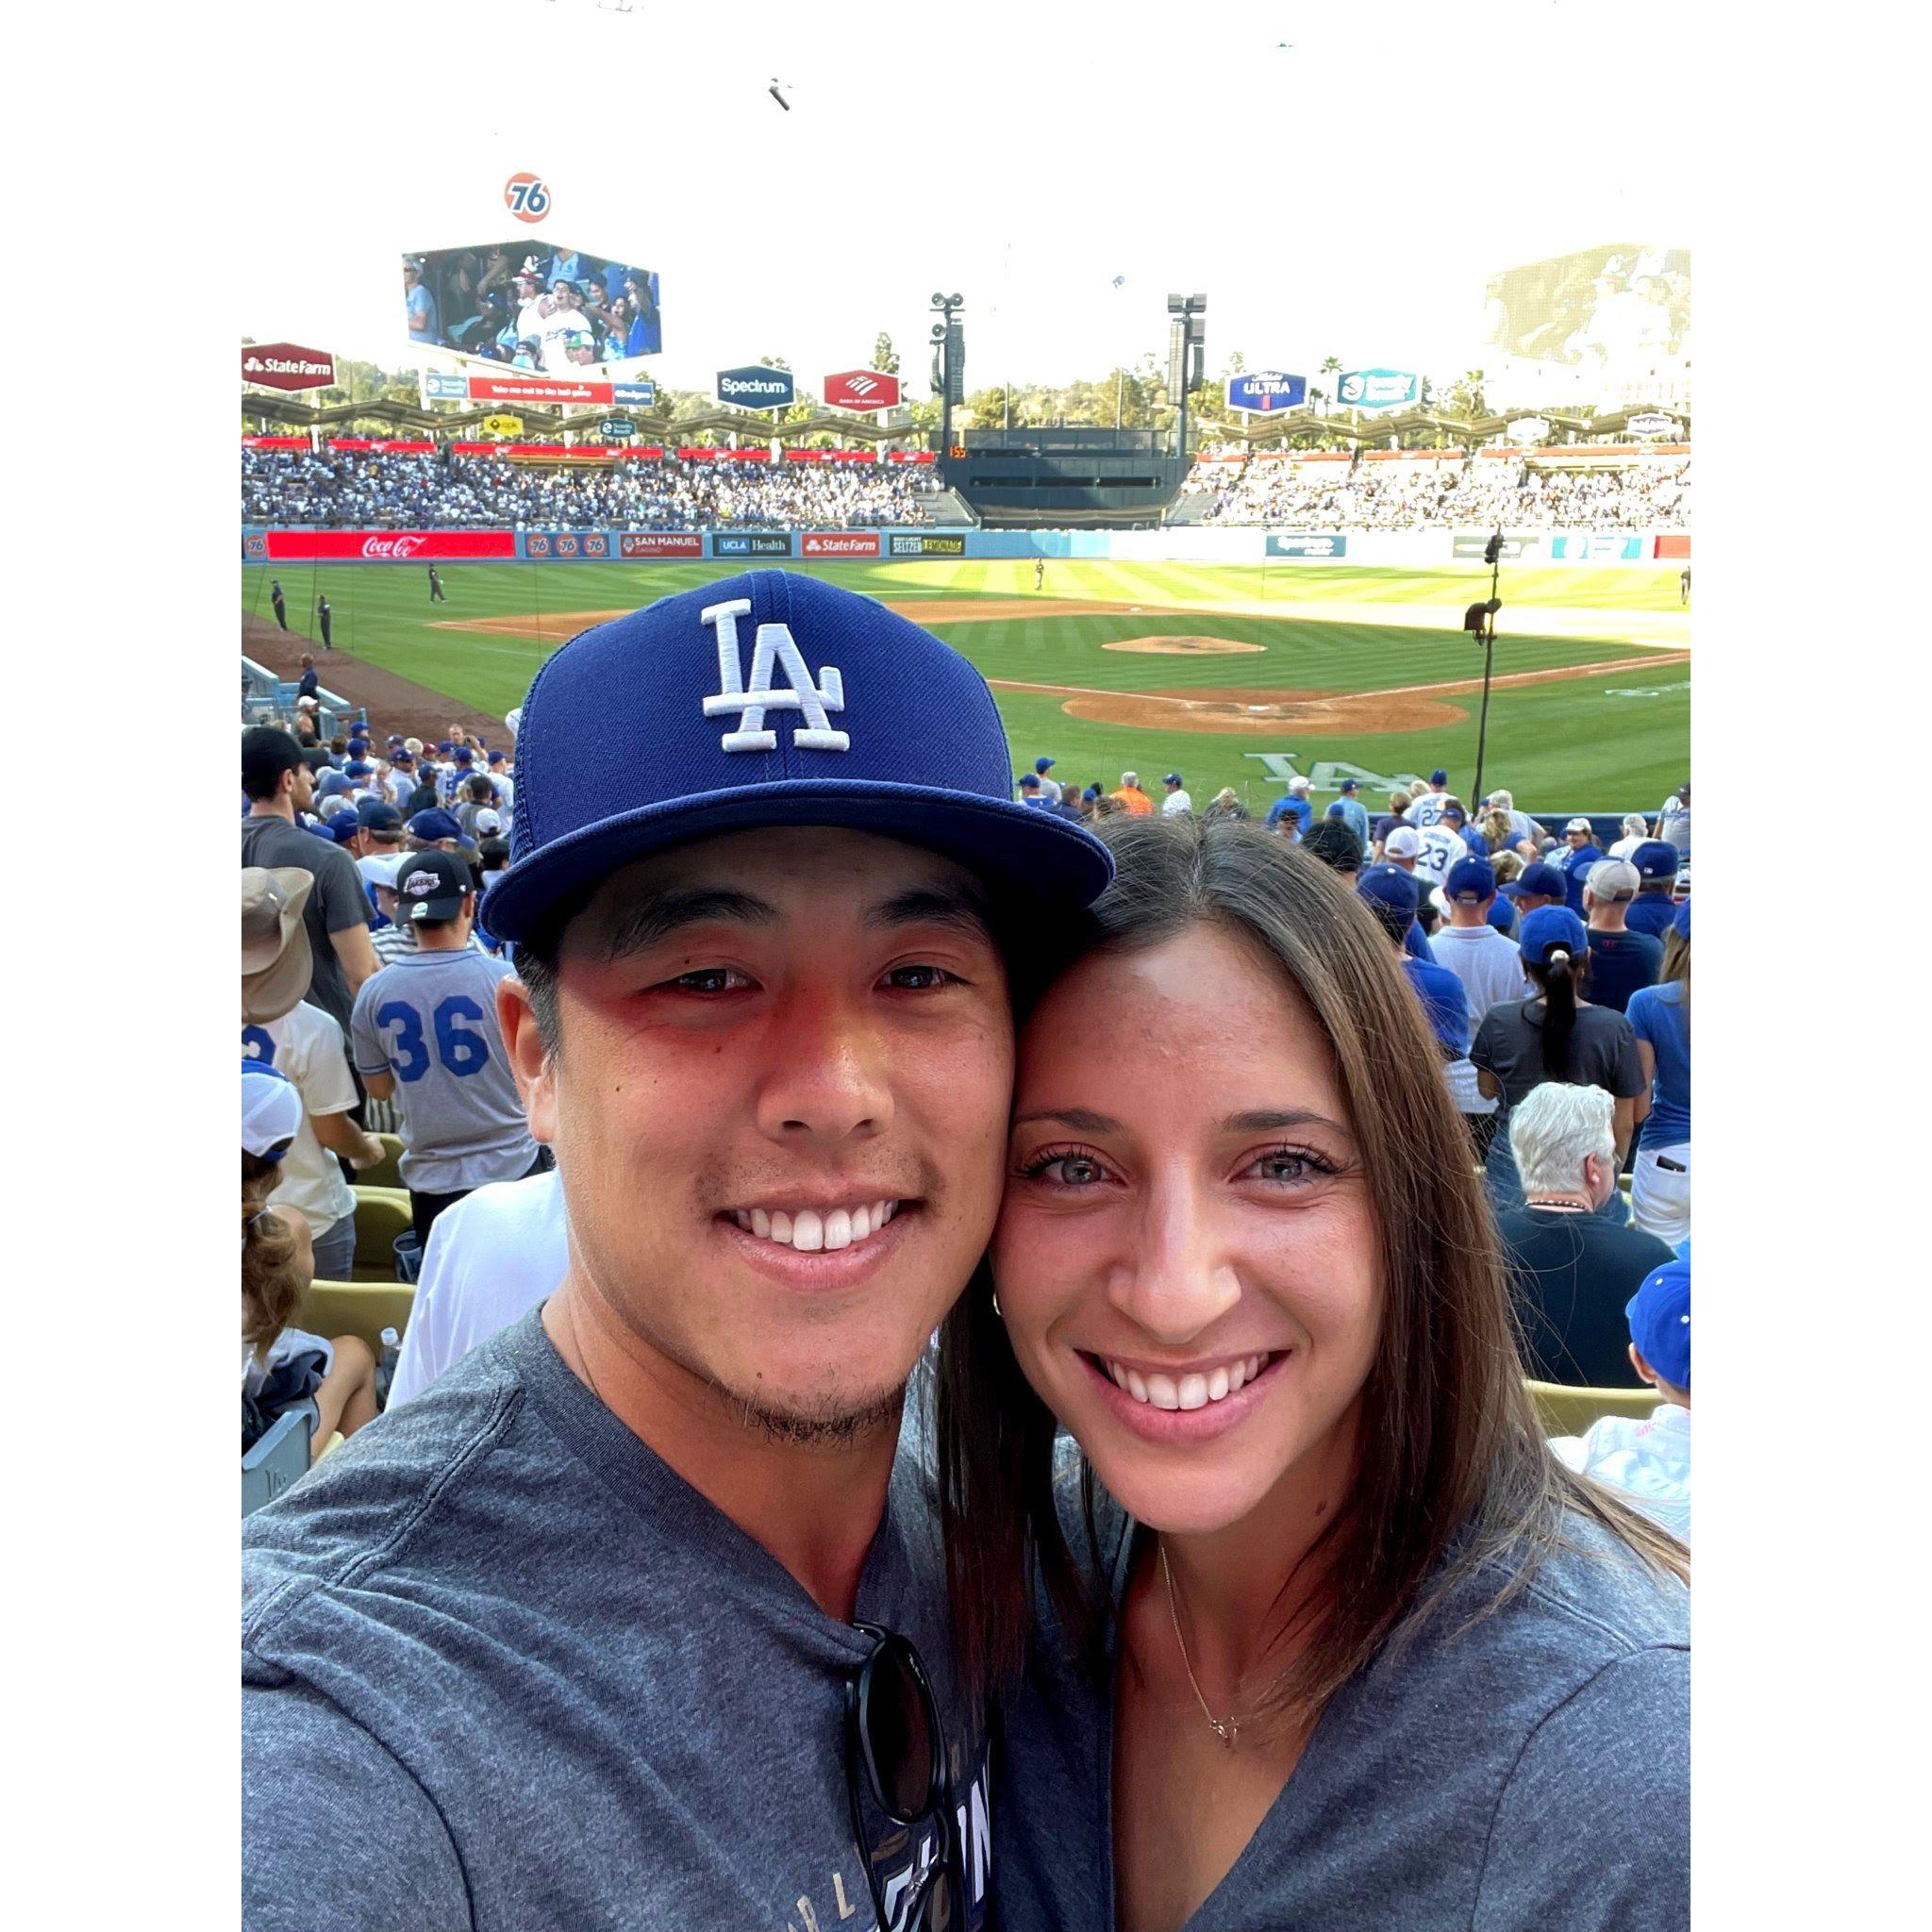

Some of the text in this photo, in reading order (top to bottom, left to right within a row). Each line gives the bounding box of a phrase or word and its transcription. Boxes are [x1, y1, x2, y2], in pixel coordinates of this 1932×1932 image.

[511, 182, 546, 213] 76
[721, 377, 786, 395] Spectrum
[1243, 380, 1291, 395] ULTRA
[531, 538, 604, 552] 76 76 76
[635, 537, 700, 546] SAN MANUEL
[723, 539, 786, 551] UCLA Health
[893, 541, 923, 553] SELTZER
[701, 598, 850, 753] LA
[1243, 753, 1427, 792] LA
[377, 994, 490, 1083] 36
